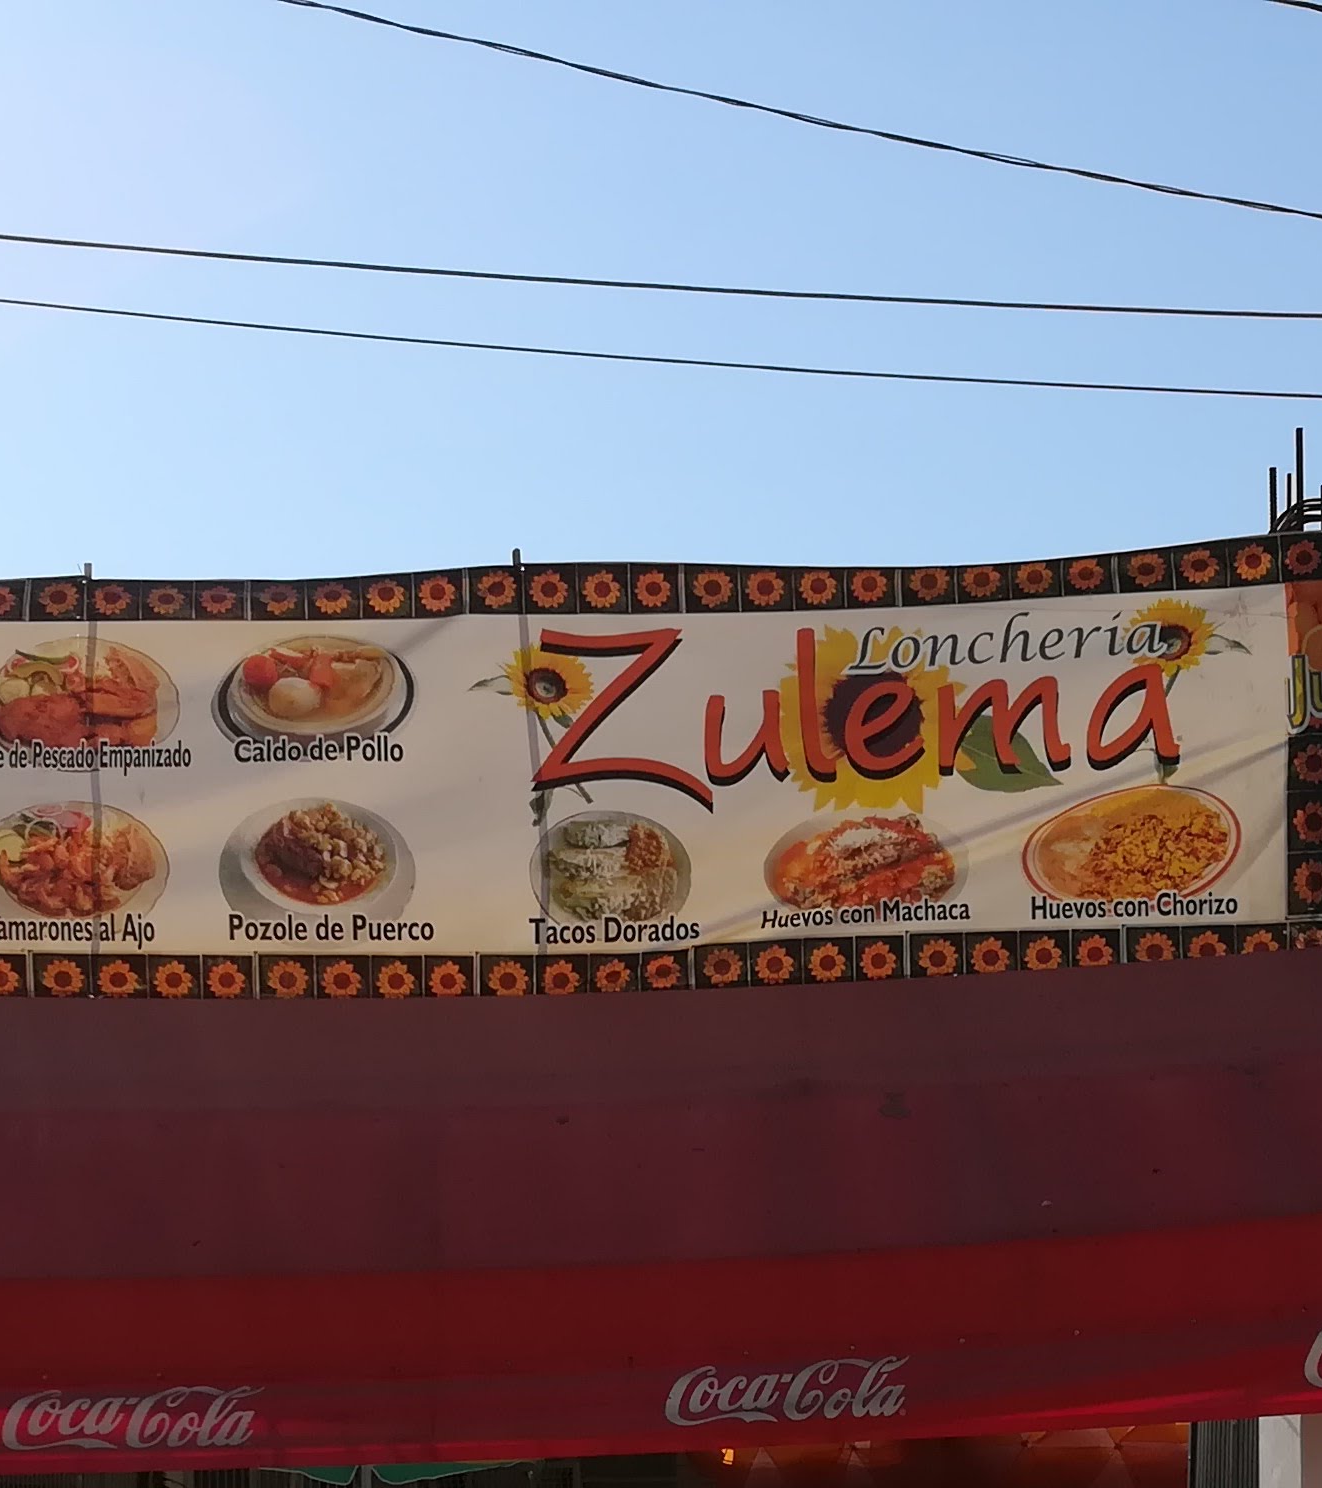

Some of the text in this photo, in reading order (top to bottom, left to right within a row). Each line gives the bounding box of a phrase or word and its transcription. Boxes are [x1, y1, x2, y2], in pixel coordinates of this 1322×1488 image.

[850, 612, 1165, 672] Lonchería
[531, 626, 1182, 814] Zulema
[8, 742, 28, 769] de
[32, 741, 95, 770] Pescado
[99, 740, 192, 776] Empanizado
[233, 734, 405, 765] Caldo de Pollo
[760, 898, 971, 931] Huevos con Machaca
[1030, 892, 1239, 921] Huevos con Chorizo
[98, 915, 117, 942] al
[122, 912, 157, 950] Ajo
[228, 913, 435, 942] Pozole de Puerco
[528, 916, 701, 945] Tacos Dorados
[665, 1355, 909, 1426] Coca-Cola
[1, 1385, 265, 1450] Coca-Cola
